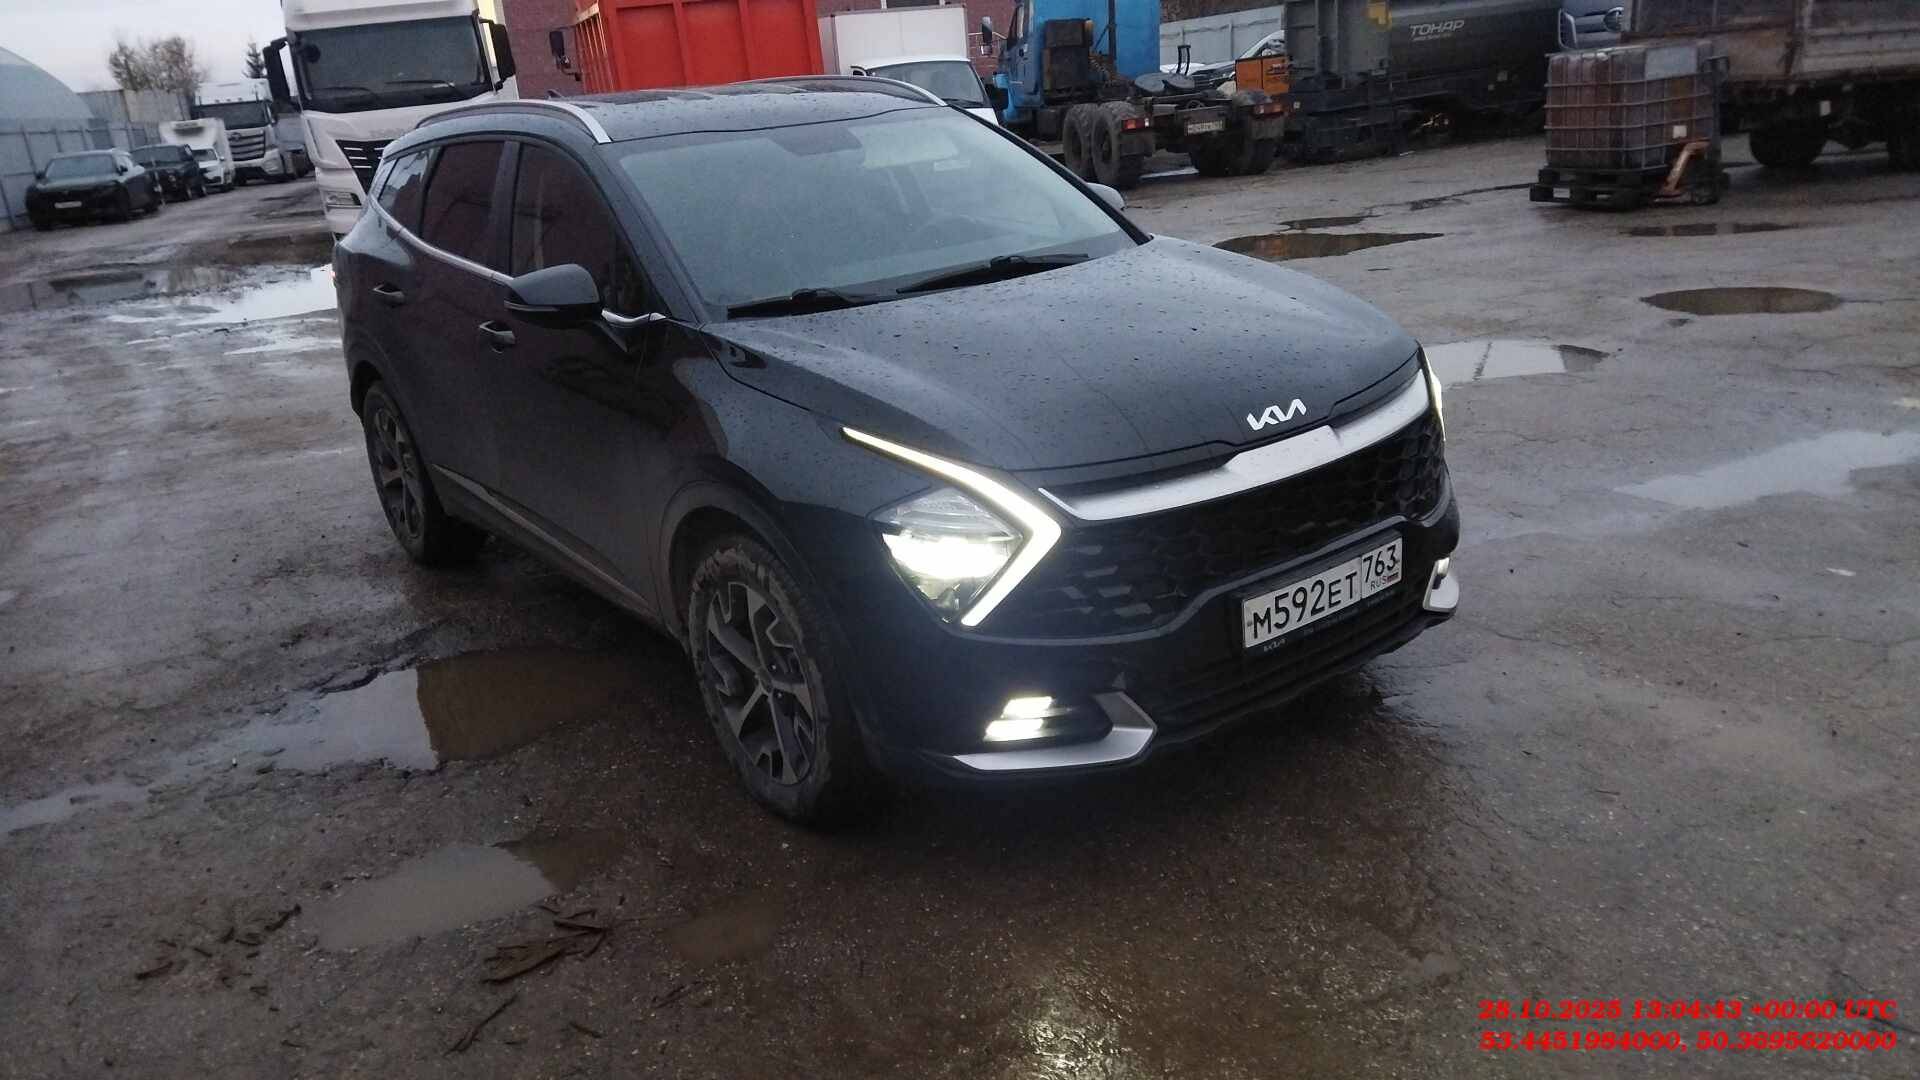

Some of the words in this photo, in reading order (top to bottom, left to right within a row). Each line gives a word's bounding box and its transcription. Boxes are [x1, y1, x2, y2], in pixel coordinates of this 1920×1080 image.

[1409, 20, 1465, 38] ТОНАР
[1246, 398, 1307, 431] KIA
[1252, 571, 1358, 639] М592ЕТ
[1362, 544, 1397, 583] 763
[1370, 575, 1387, 591] RUS
